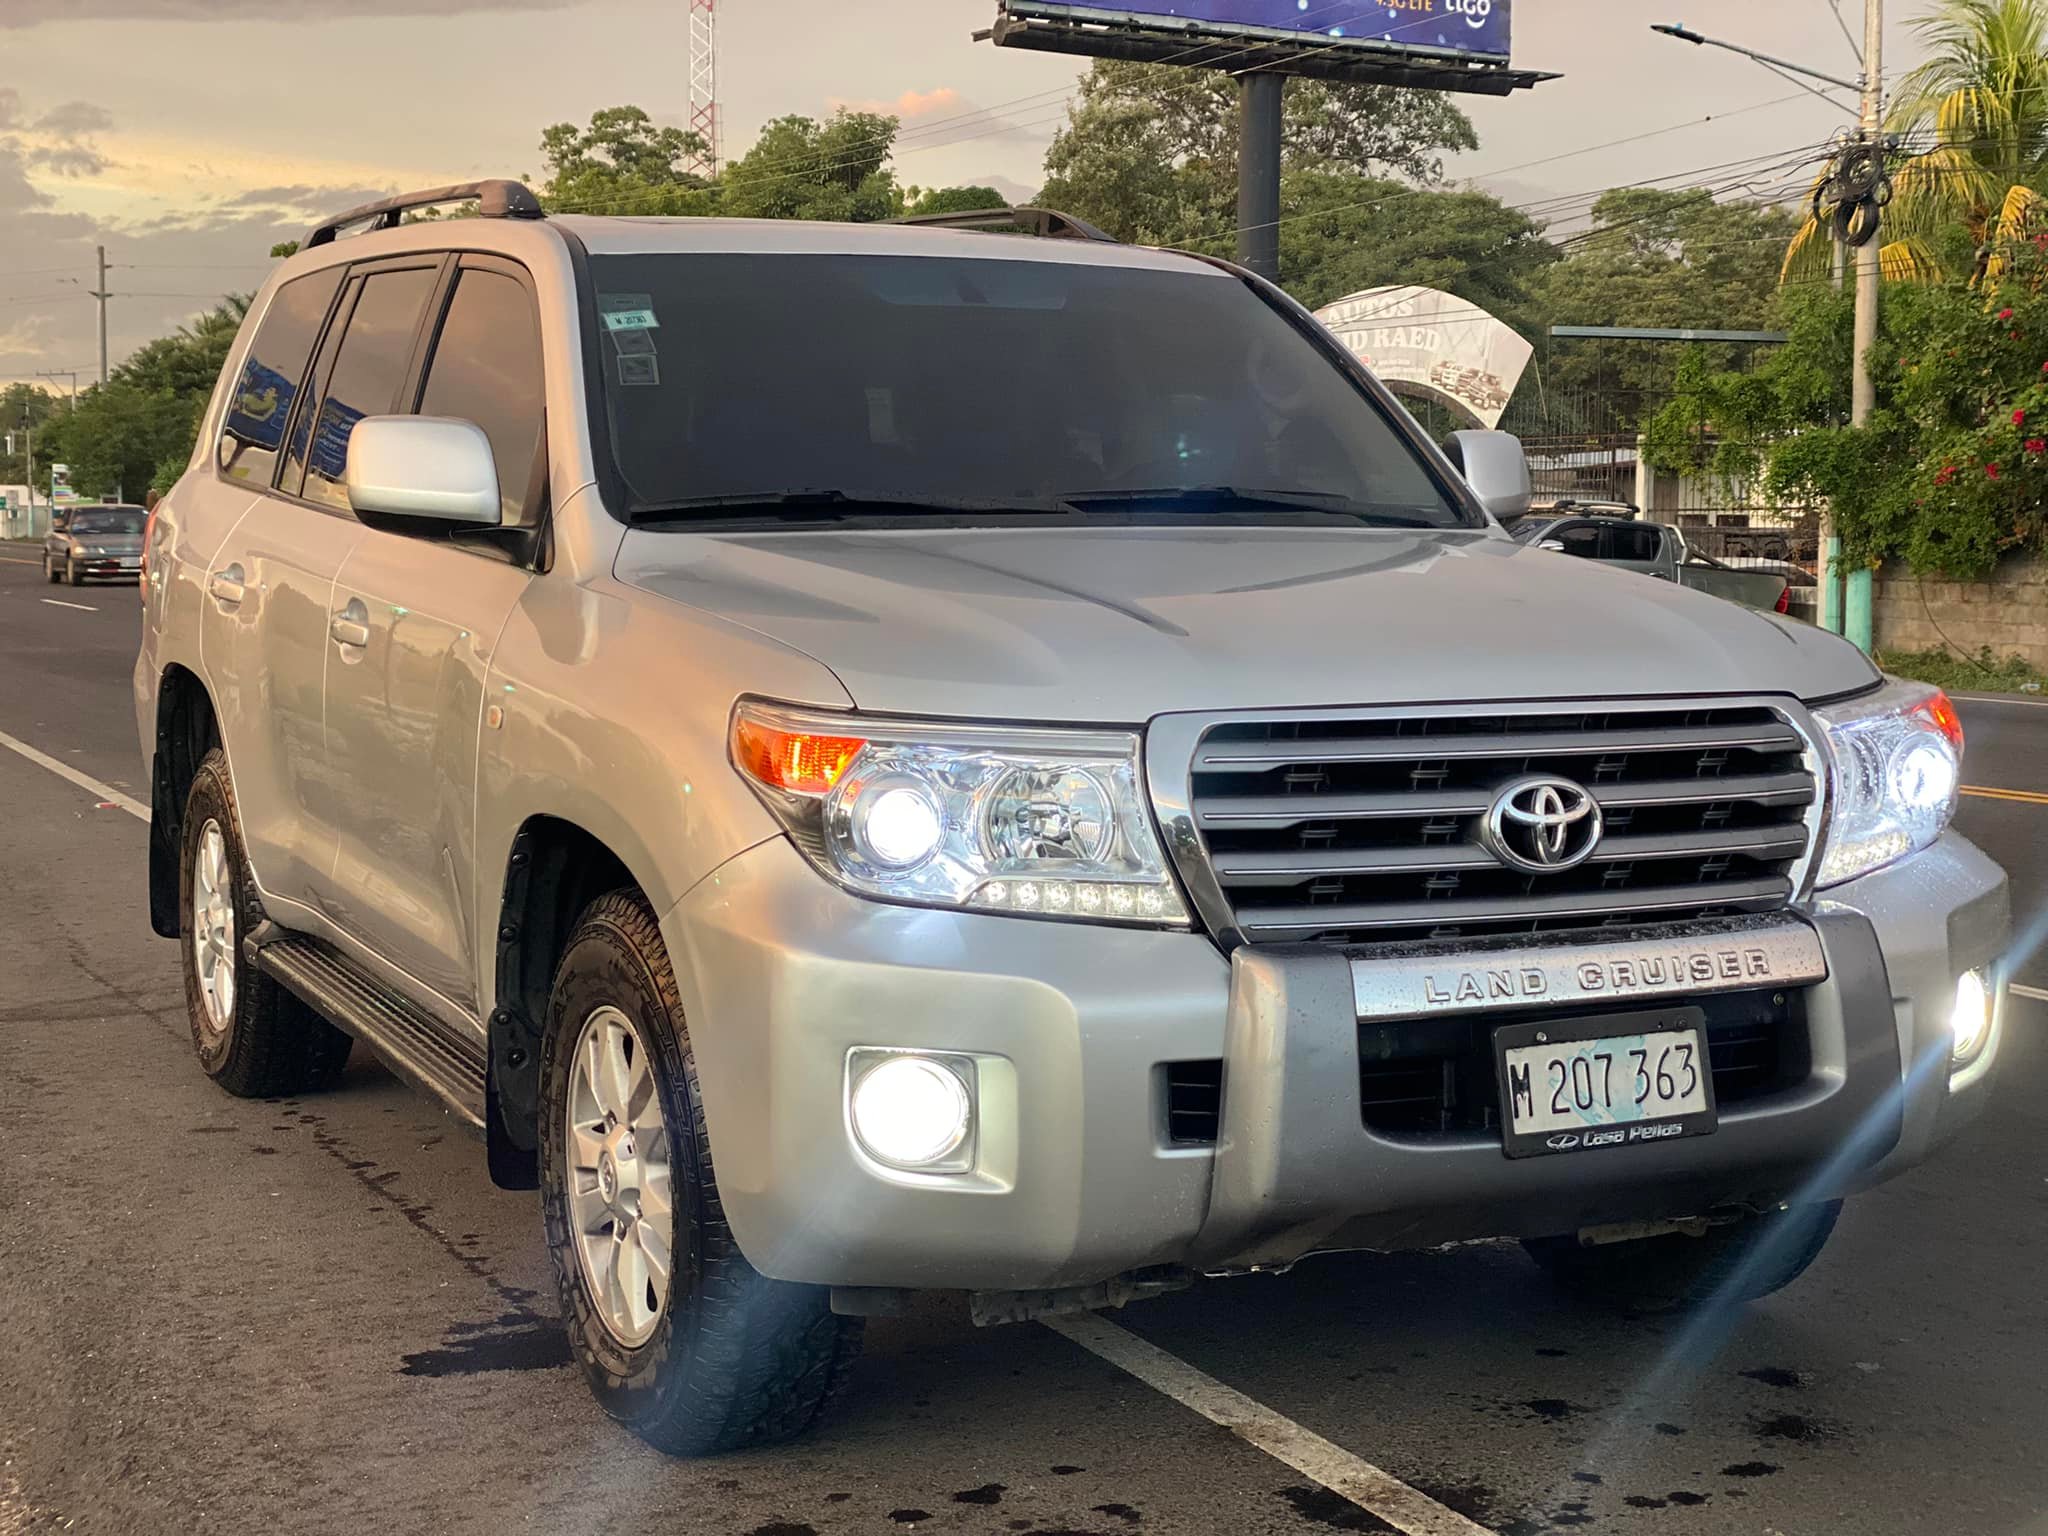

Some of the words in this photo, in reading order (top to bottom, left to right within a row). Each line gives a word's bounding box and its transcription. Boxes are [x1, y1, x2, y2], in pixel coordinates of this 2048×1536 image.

[1327, 297, 1414, 321] AUTOS
[1372, 326, 1440, 351] RAED
[1424, 968, 1548, 1002] LAND
[1577, 949, 1770, 990] CRUISER
[1510, 1062, 1533, 1119] M
[1548, 1053, 1612, 1115] 207
[1629, 1043, 1697, 1104] 363
